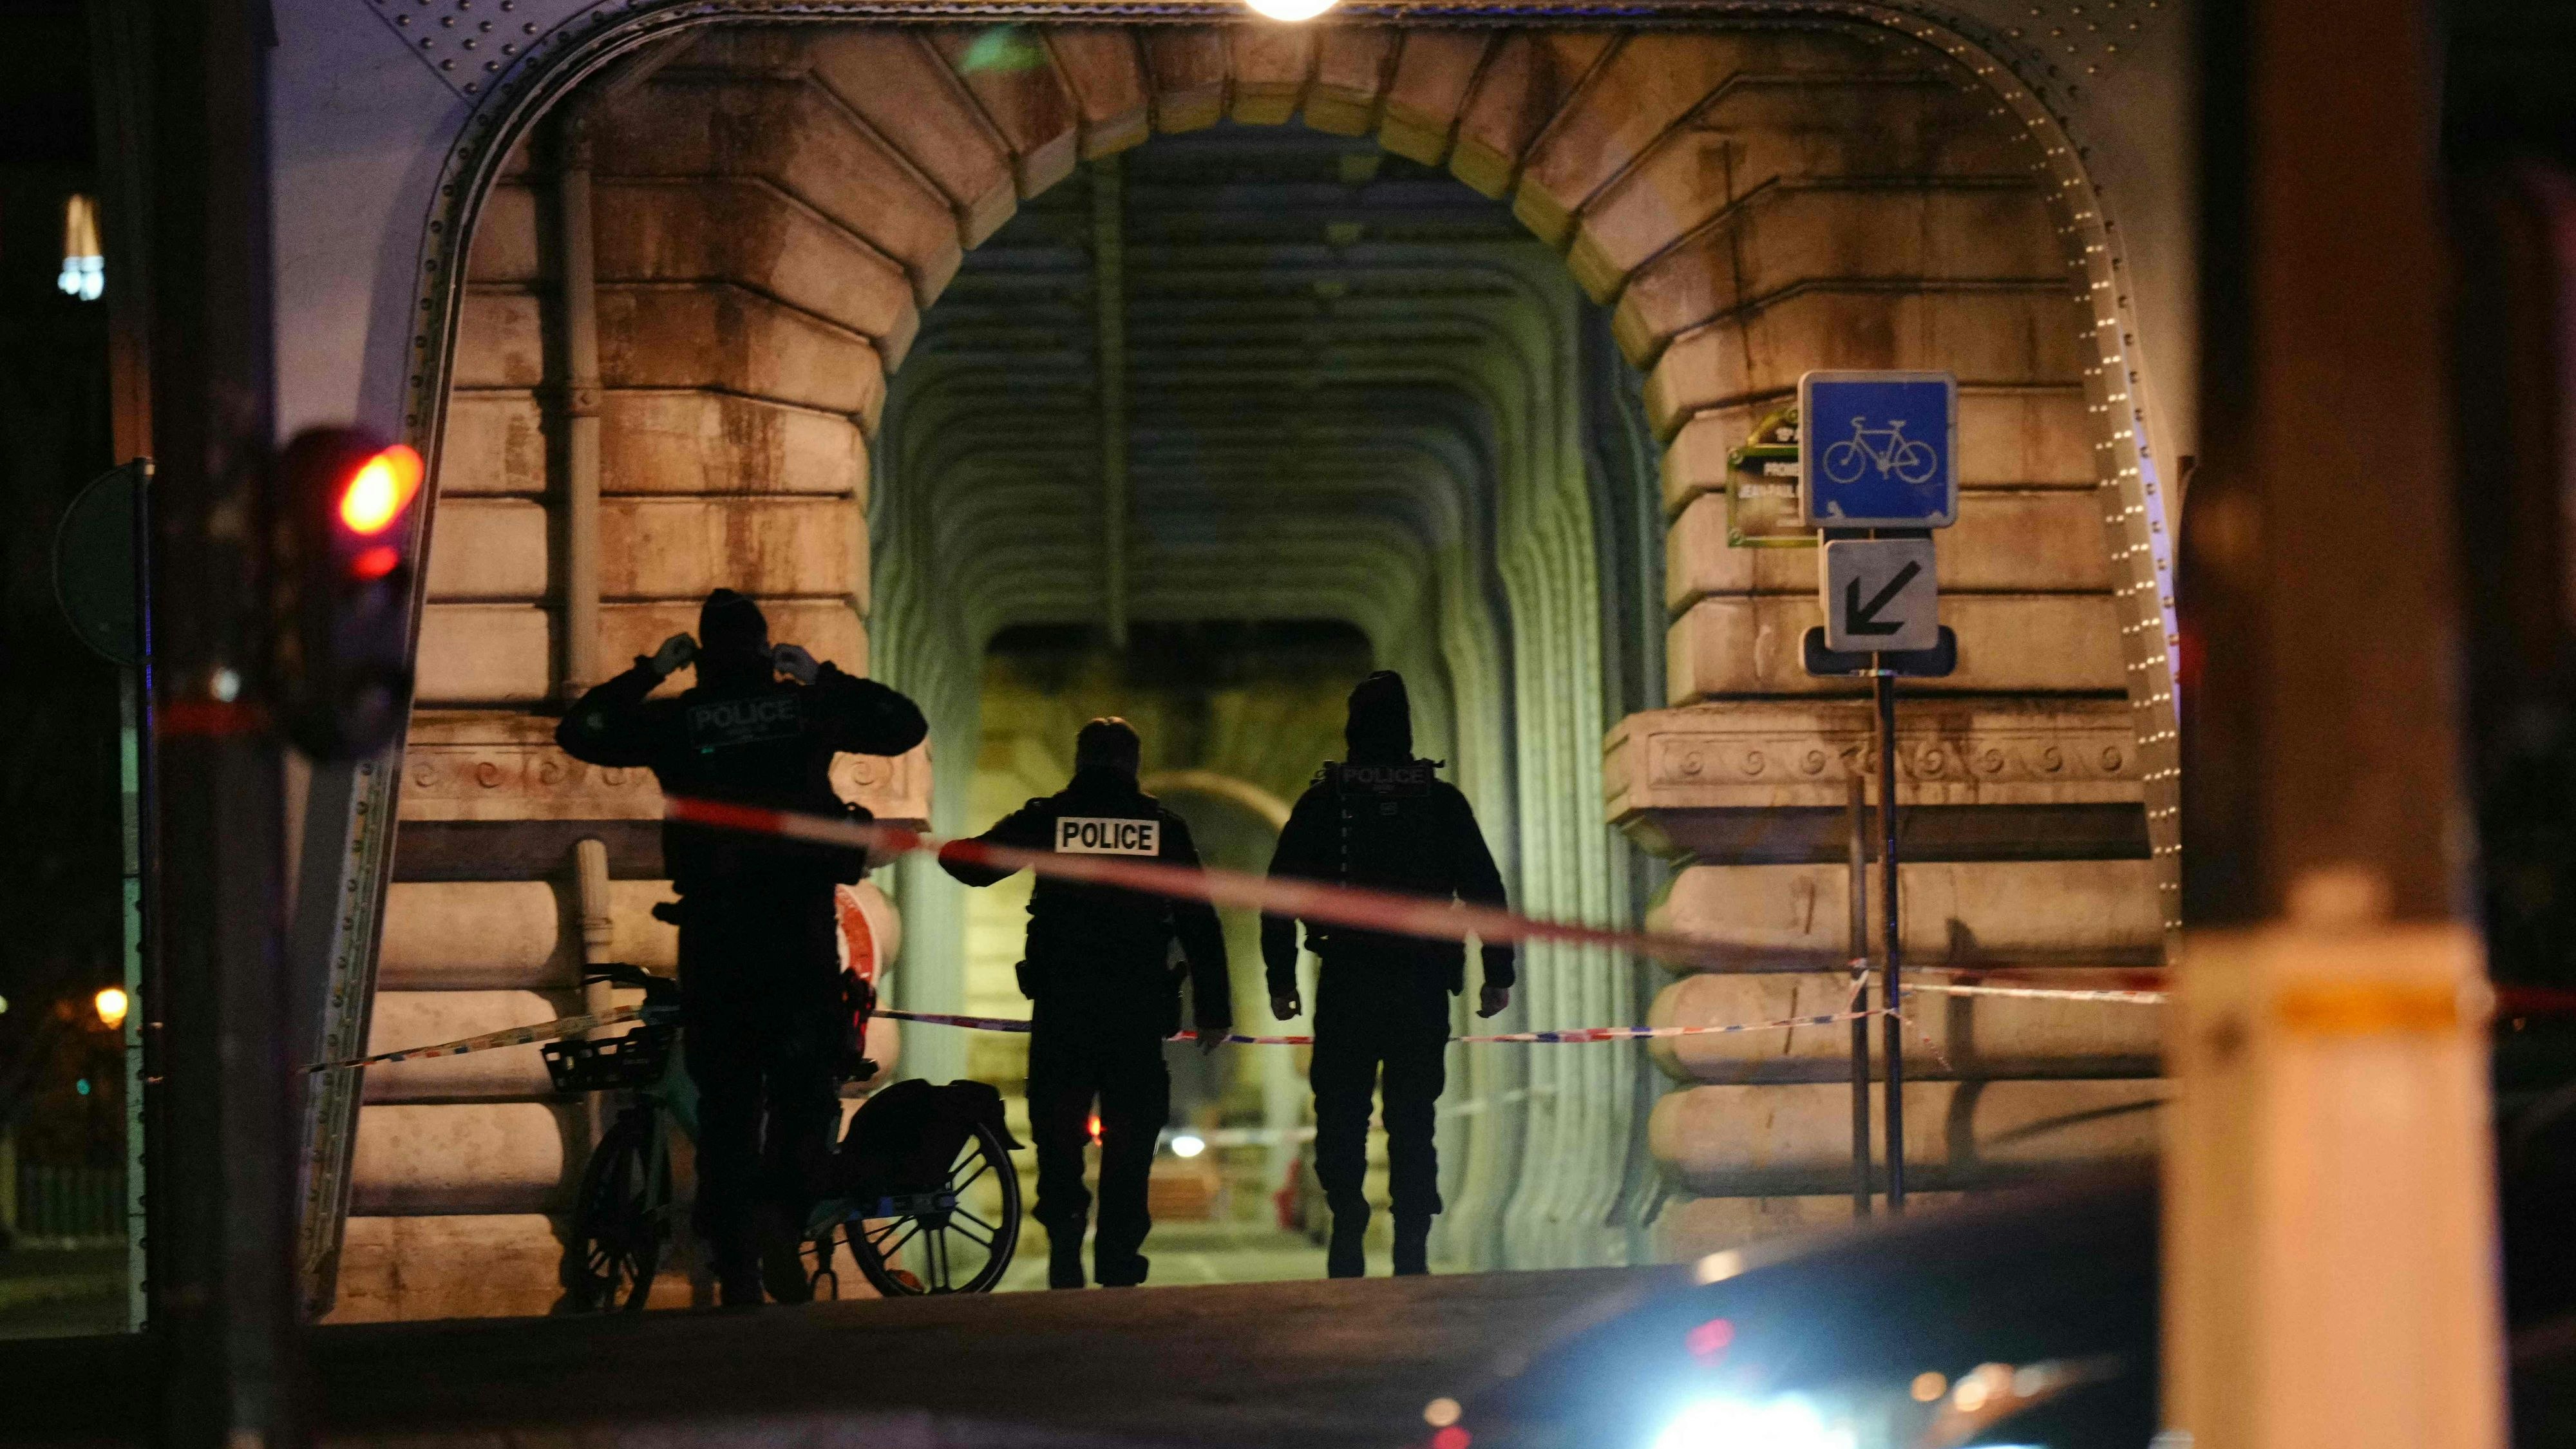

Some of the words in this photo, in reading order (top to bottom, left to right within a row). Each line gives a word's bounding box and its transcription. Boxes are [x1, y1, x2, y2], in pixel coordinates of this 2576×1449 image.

[695, 699, 795, 730] POLICE
[1343, 767, 1425, 784] POLICE
[1063, 822, 1153, 851] POLICE
